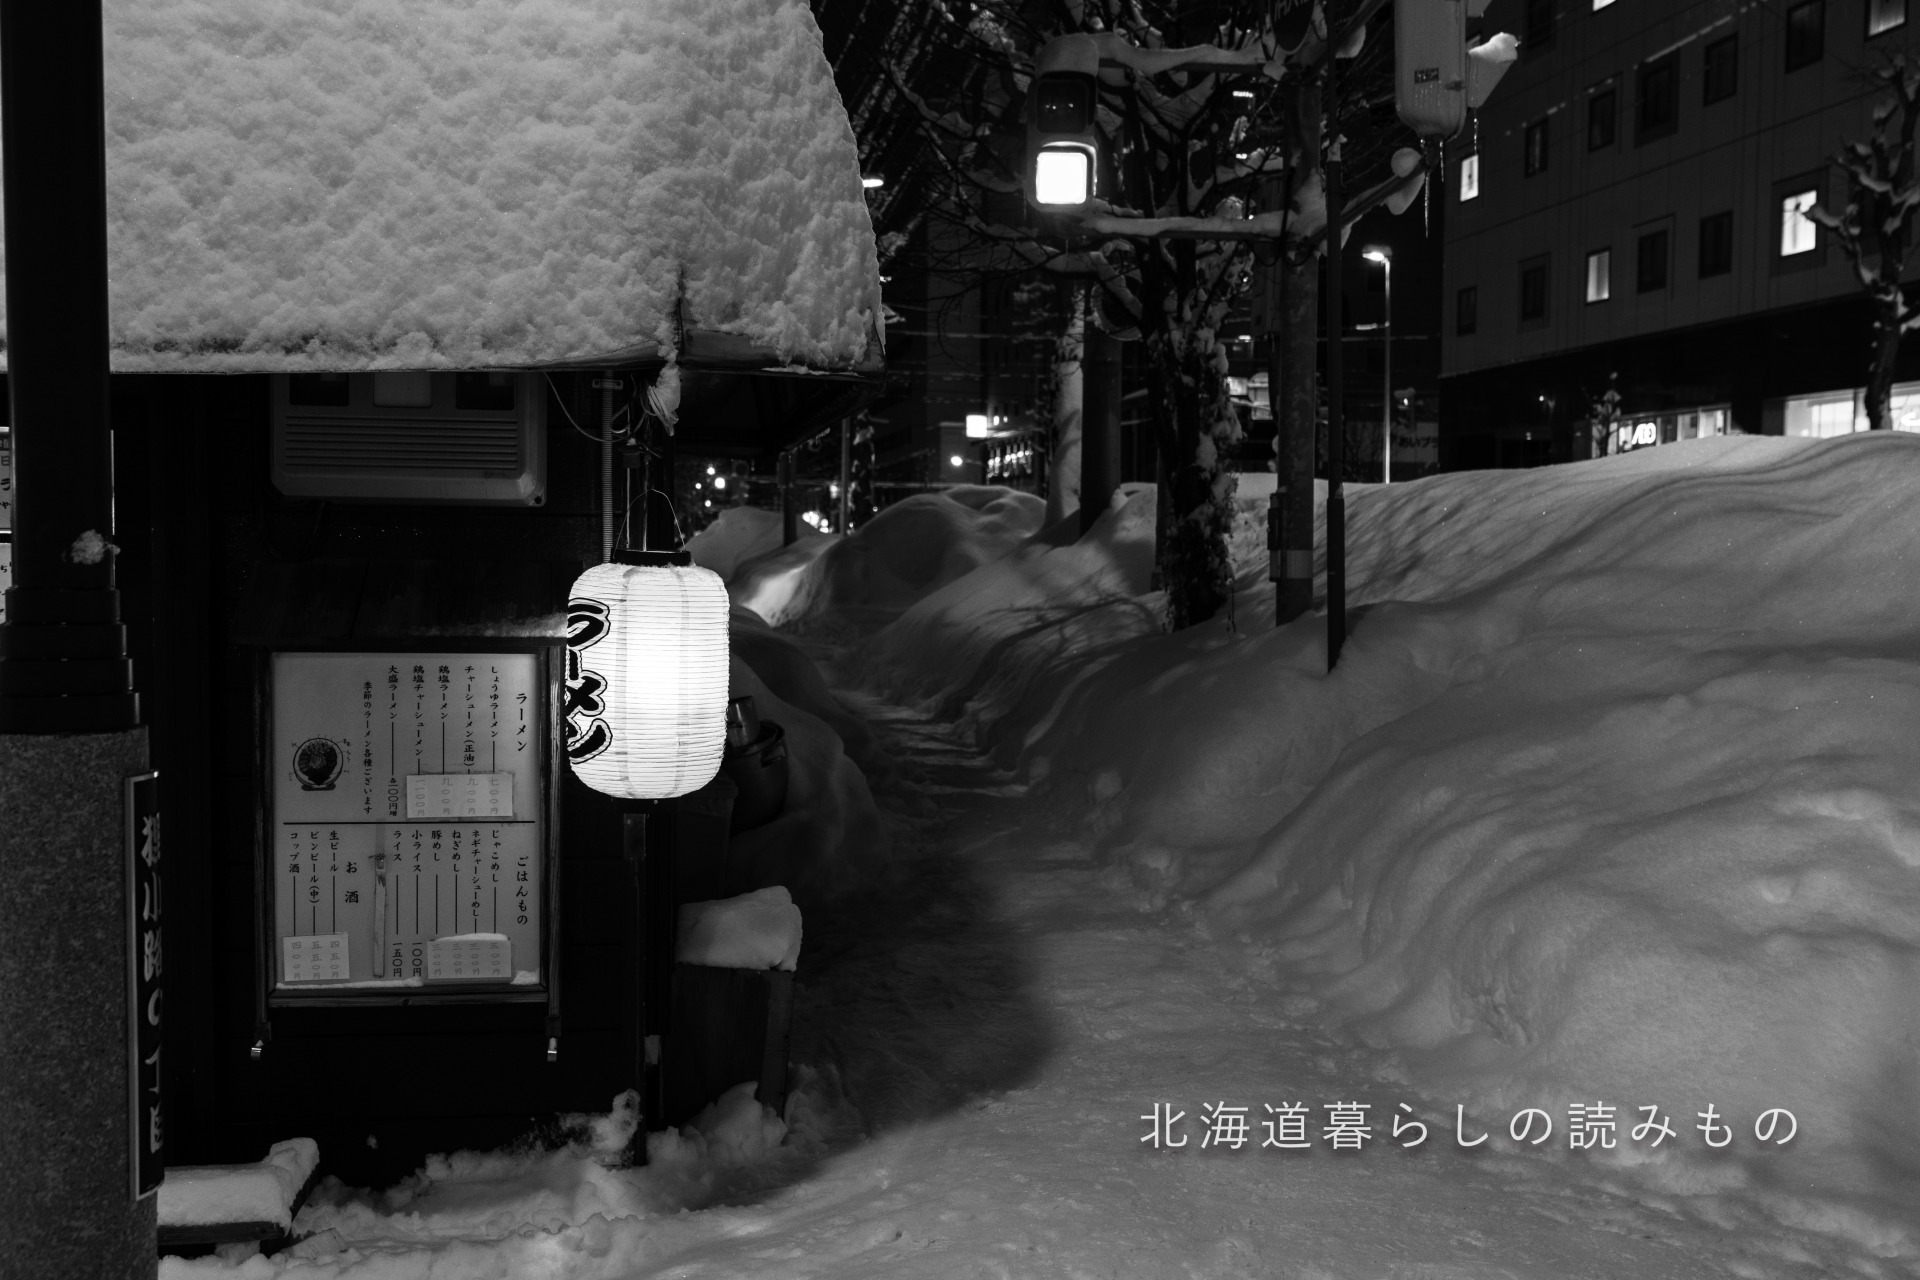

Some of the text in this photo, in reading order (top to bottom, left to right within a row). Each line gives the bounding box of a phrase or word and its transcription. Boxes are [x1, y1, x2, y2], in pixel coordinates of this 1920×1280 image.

[387, 664, 400, 720] 大盛ラーメン
[412, 664, 425, 756] 鶏塩チャーシューメン
[437, 664, 451, 720] 鶏塩ラーメン
[489, 665, 500, 738] しょうゆラーメン
[362, 680, 373, 815] 季節のラーメン各種ございます
[515, 692, 528, 752] ラーメン
[288, 832, 300, 874] コップ酒
[308, 830, 320, 904] ビンビール（中）
[328, 829, 340, 872] 生ビール
[392, 830, 402, 862] ライス
[411, 829, 423, 873] 小ライス
[430, 829, 443, 862] 豚めし
[451, 829, 462, 873] ねぎめし
[470, 829, 482, 917] ネギチャーシューめし
[490, 829, 502, 883] じゃこめし
[344, 861, 360, 904] お酒
[515, 855, 529, 926] ごはんもの
[391, 942, 404, 978] 一五〇円
